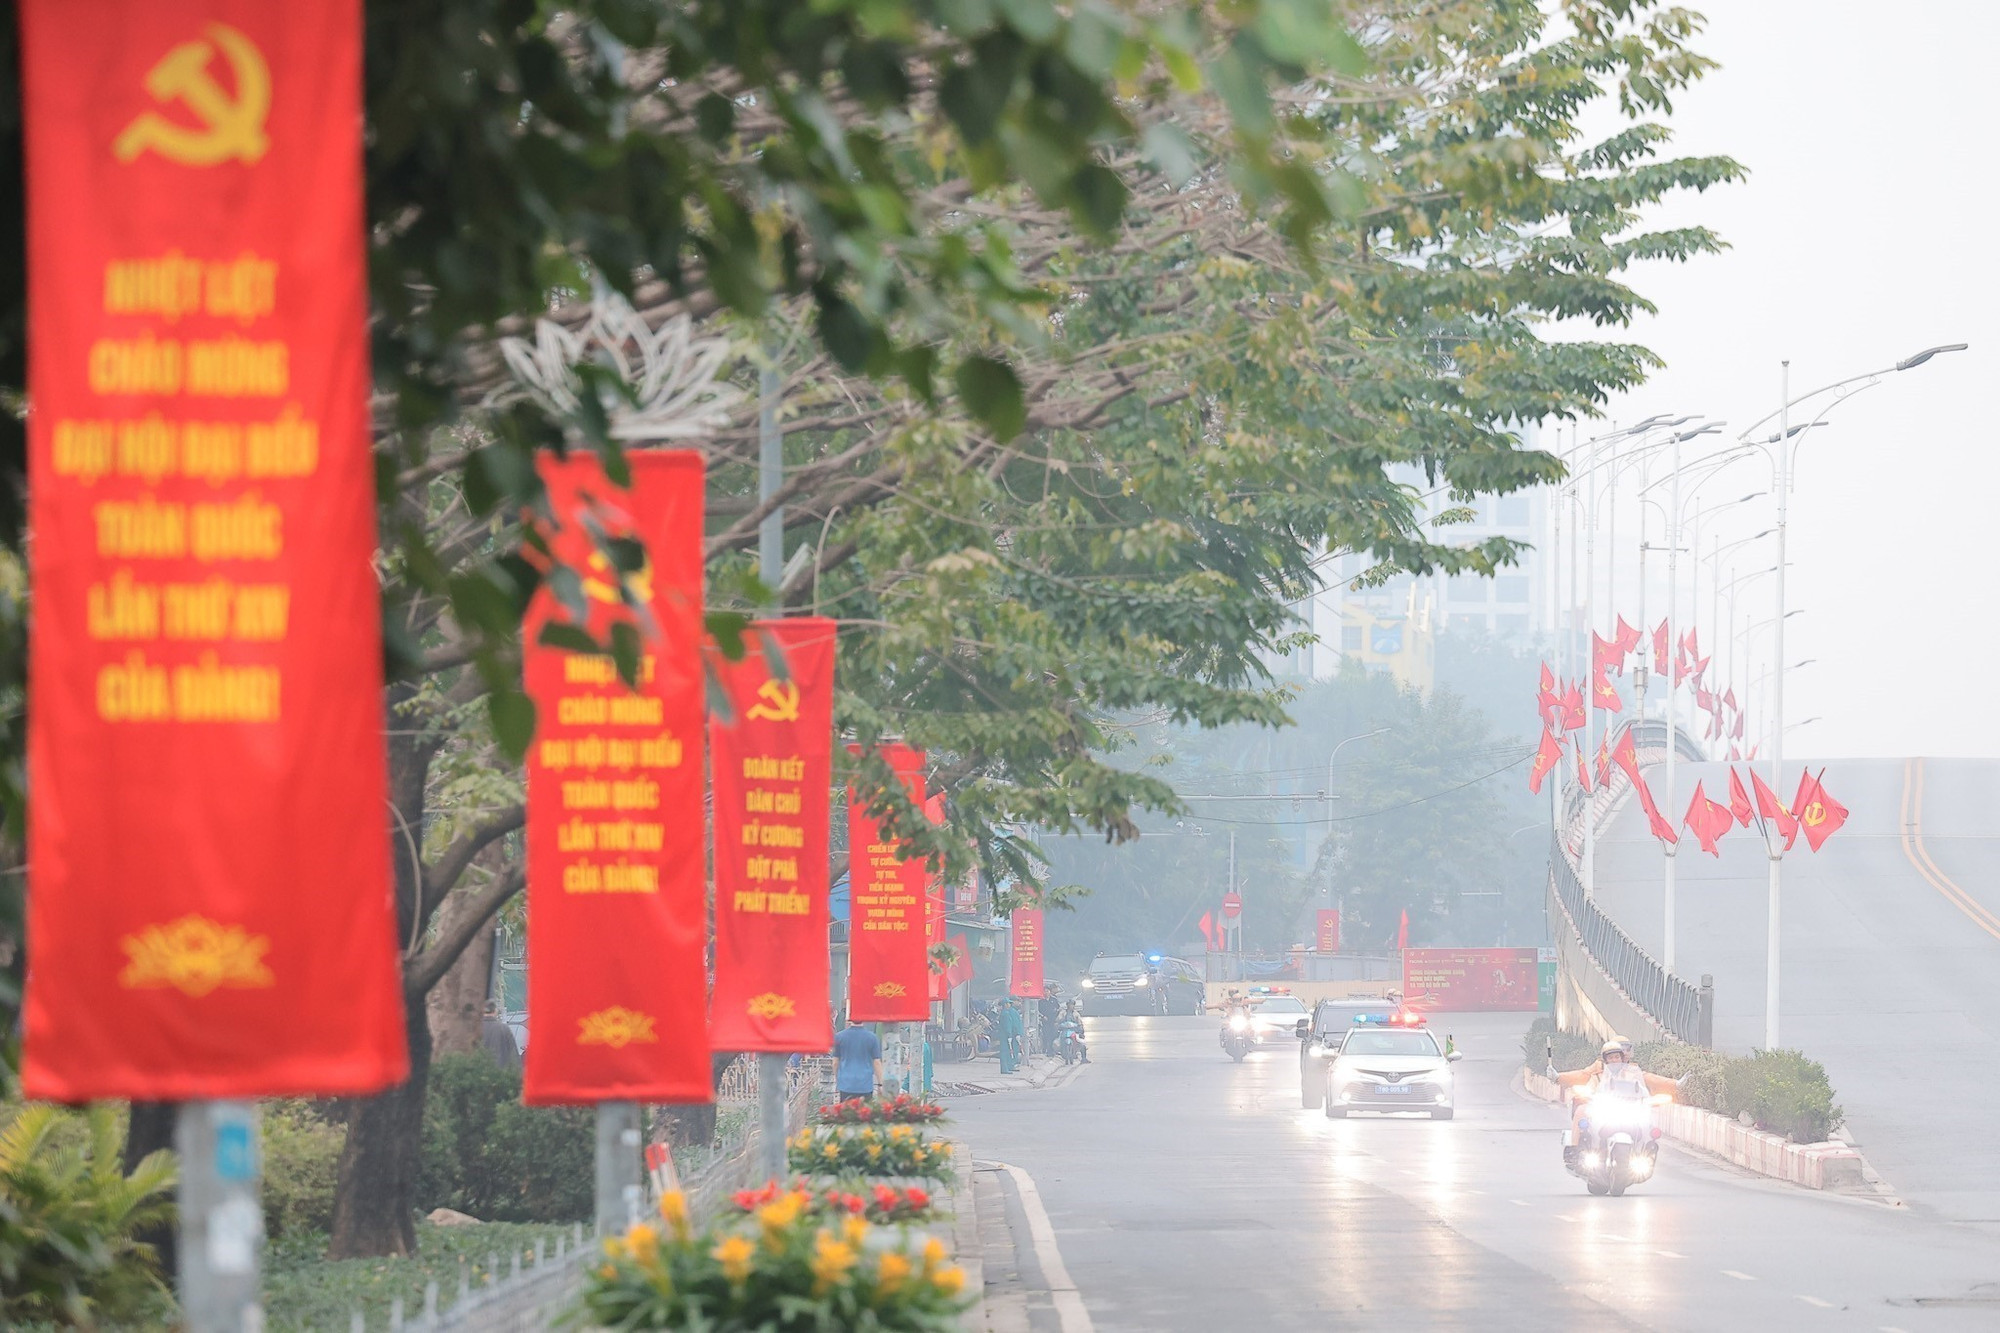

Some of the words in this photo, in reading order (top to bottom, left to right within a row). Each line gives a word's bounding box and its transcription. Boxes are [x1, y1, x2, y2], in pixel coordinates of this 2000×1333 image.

[204, 250, 278, 326] LIỆT
[88, 329, 182, 396] CHÀO
[185, 332, 289, 397] MỪNG
[52, 417, 114, 487] ĐẠI
[116, 409, 178, 485] HỘI
[180, 420, 243, 487] ĐẠI
[245, 401, 318, 478] BIỂU
[94, 492, 187, 560] TOÀN
[190, 488, 283, 564] QUỐC
[87, 565, 160, 642] LẦN
[162, 573, 231, 641] THỨ
[97, 648, 170, 721] CỦA
[558, 690, 608, 725] CHÀO
[609, 691, 664, 725] MỪNG
[540, 739, 572, 773] ĐẠI
[574, 733, 606, 773] HỘI
[608, 739, 637, 773] ĐẠI
[639, 729, 682, 768] BIỂU
[743, 753, 779, 779] ĐOÀN
[780, 753, 805, 781] KẾT
[561, 775, 610, 809] TOÀN
[612, 773, 660, 811] QUỐC
[746, 787, 774, 812] DÂN
[775, 786, 801, 814] CHỦ
[558, 815, 596, 851] LẦN
[598, 817, 632, 851] THỨ
[742, 817, 760, 845] KỶ
[760, 824, 804, 848] CƯƠNG
[563, 856, 601, 894] CỦA
[747, 854, 772, 884] ĐỘT
[772, 856, 799, 881] PHÁ
[734, 887, 768, 912] PHÁT
[856, 896, 879, 905] TRONG
[889, 895, 917, 905] NGUYÊN
[863, 919, 876, 930] CỦA
[877, 920, 892, 930] DÂN
